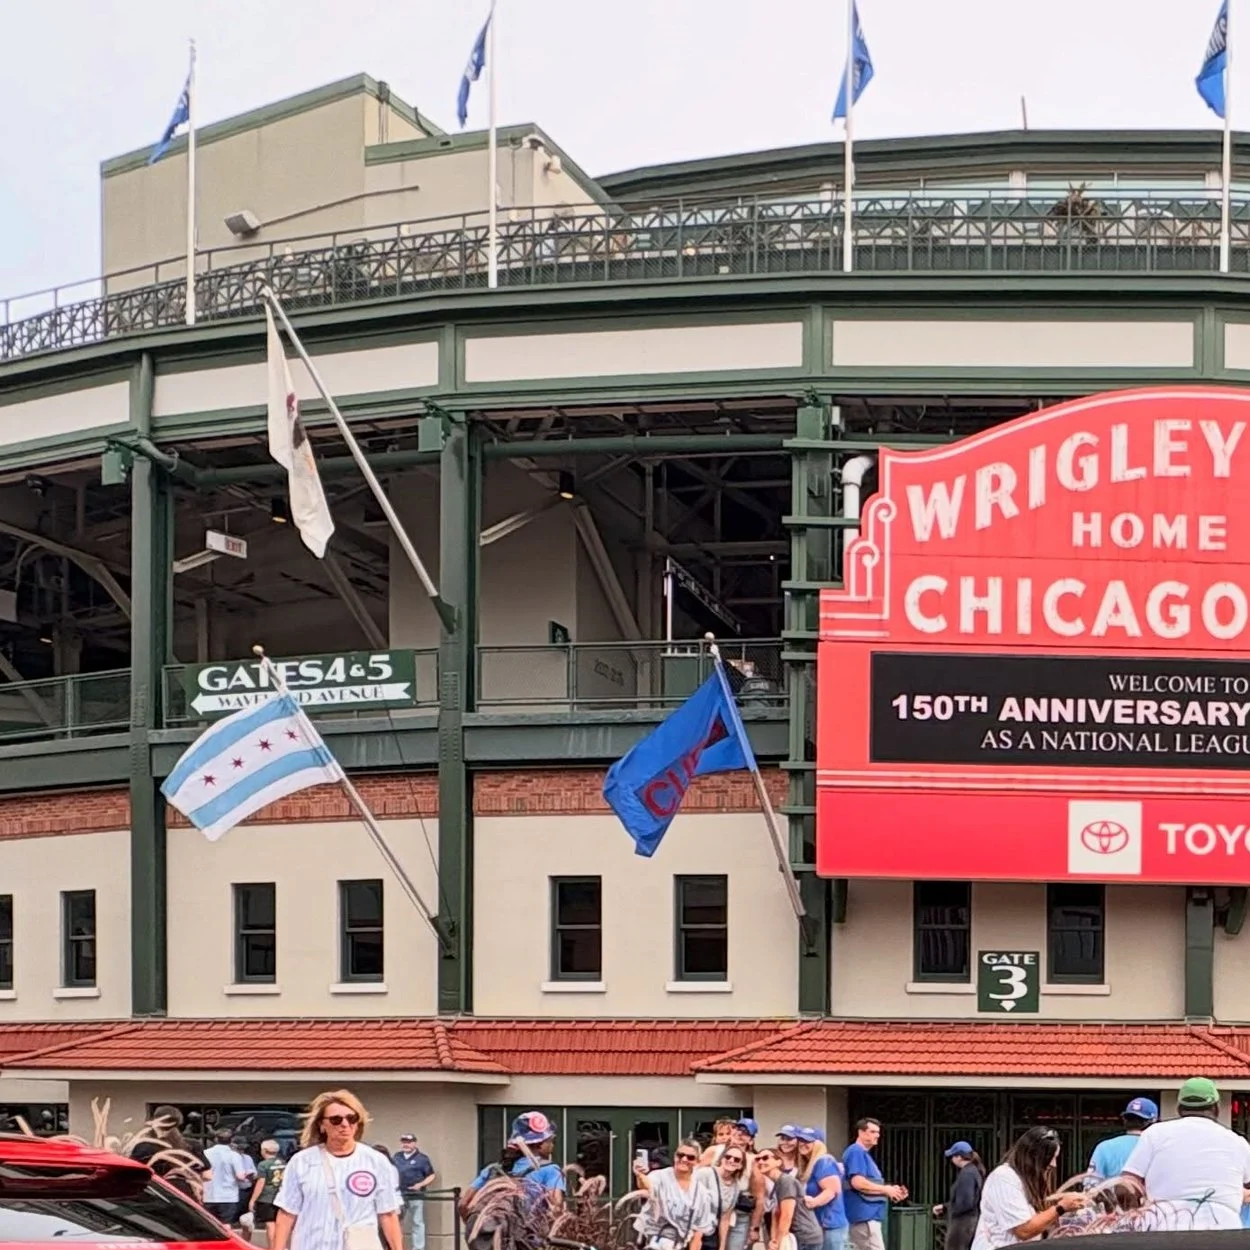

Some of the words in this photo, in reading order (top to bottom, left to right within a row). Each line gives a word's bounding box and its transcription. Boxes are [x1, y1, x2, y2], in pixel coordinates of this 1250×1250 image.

[905, 419, 1247, 543] WRIGLEY
[1072, 512, 1228, 551] HOME
[904, 574, 1250, 640] CHICAGO
[198, 659, 324, 692] GATES
[1109, 674, 1216, 694] WELCOME
[1220, 677, 1249, 694] TO
[318, 687, 383, 702] AVENUE
[892, 694, 988, 720] 150TH
[980, 730, 1014, 750] AS
[1018, 731, 1035, 750] A
[1041, 731, 1169, 753] NATIONAL
[982, 953, 1036, 965] GATE
[989, 965, 1028, 999] 3
